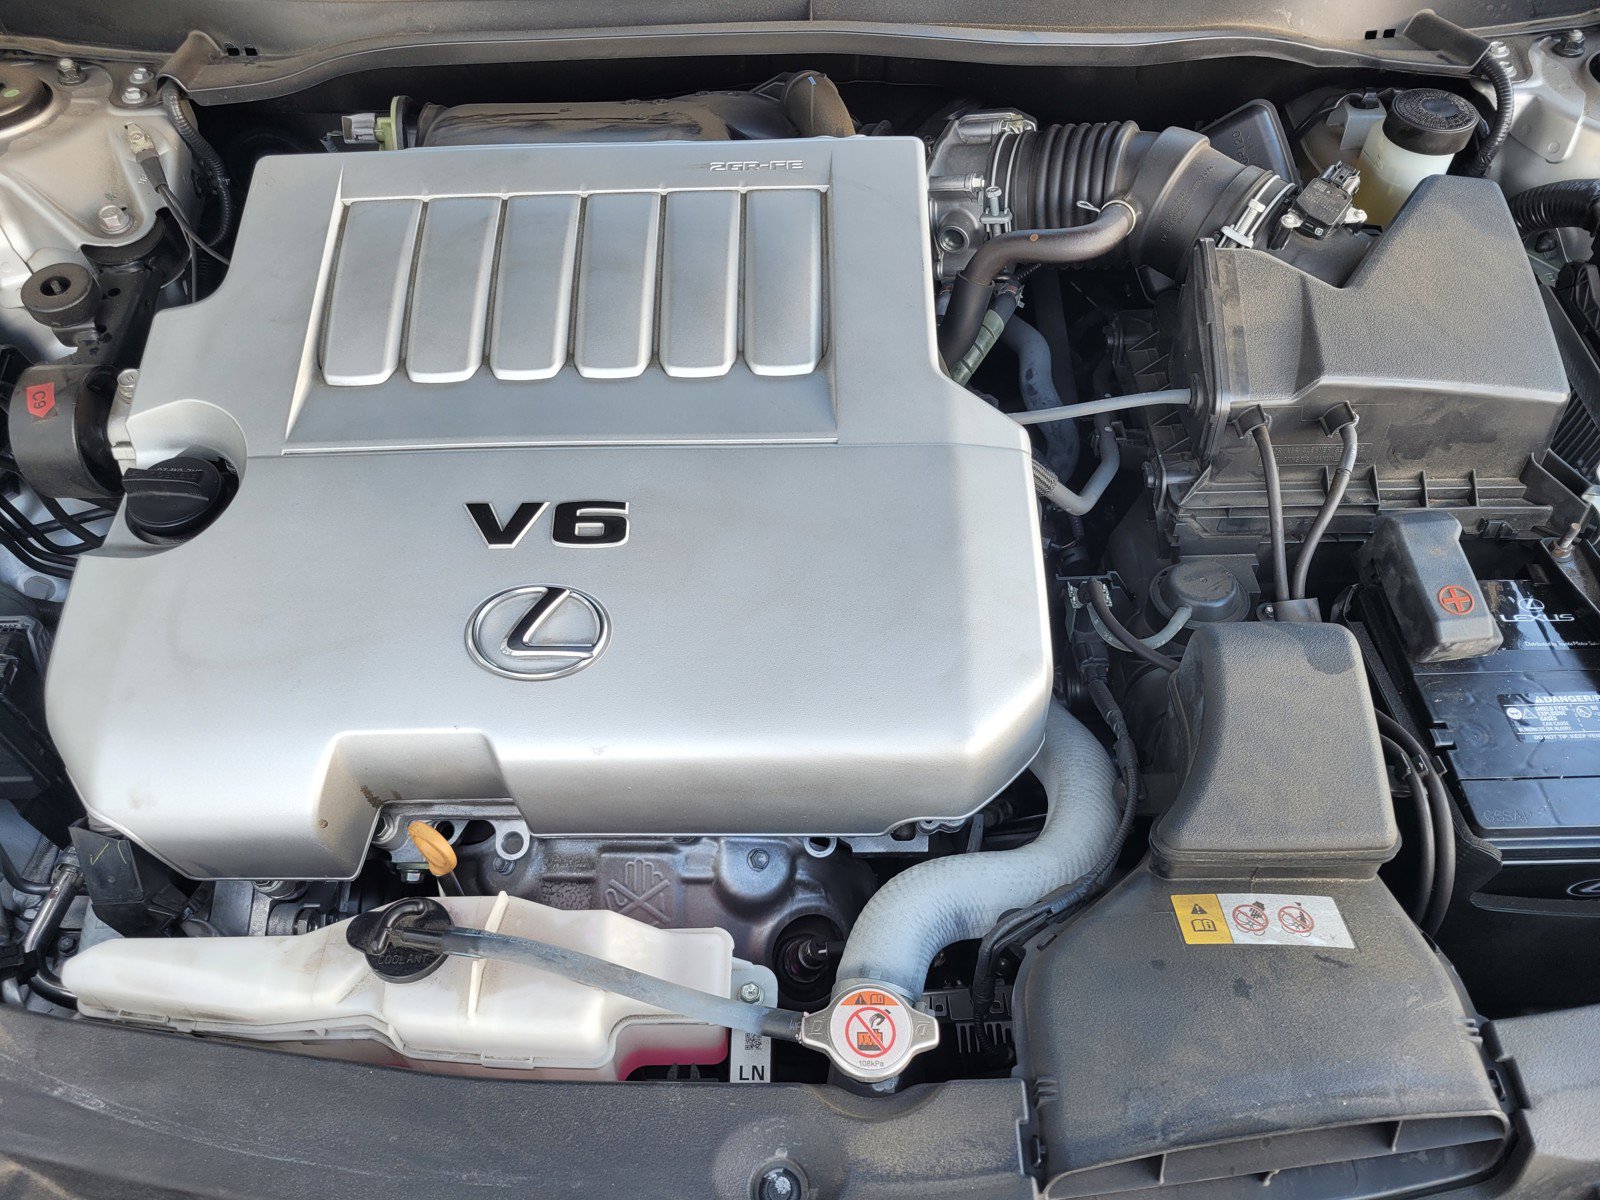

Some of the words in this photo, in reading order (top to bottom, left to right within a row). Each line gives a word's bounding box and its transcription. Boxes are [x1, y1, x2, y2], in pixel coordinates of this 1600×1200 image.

[709, 159, 804, 173] 2GR-FE
[32, 390, 47, 410] C9
[463, 501, 630, 549] V6
[1499, 613, 1576, 622] LEXUS
[377, 953, 431, 965] COOLANT
[739, 1065, 765, 1081] LN
